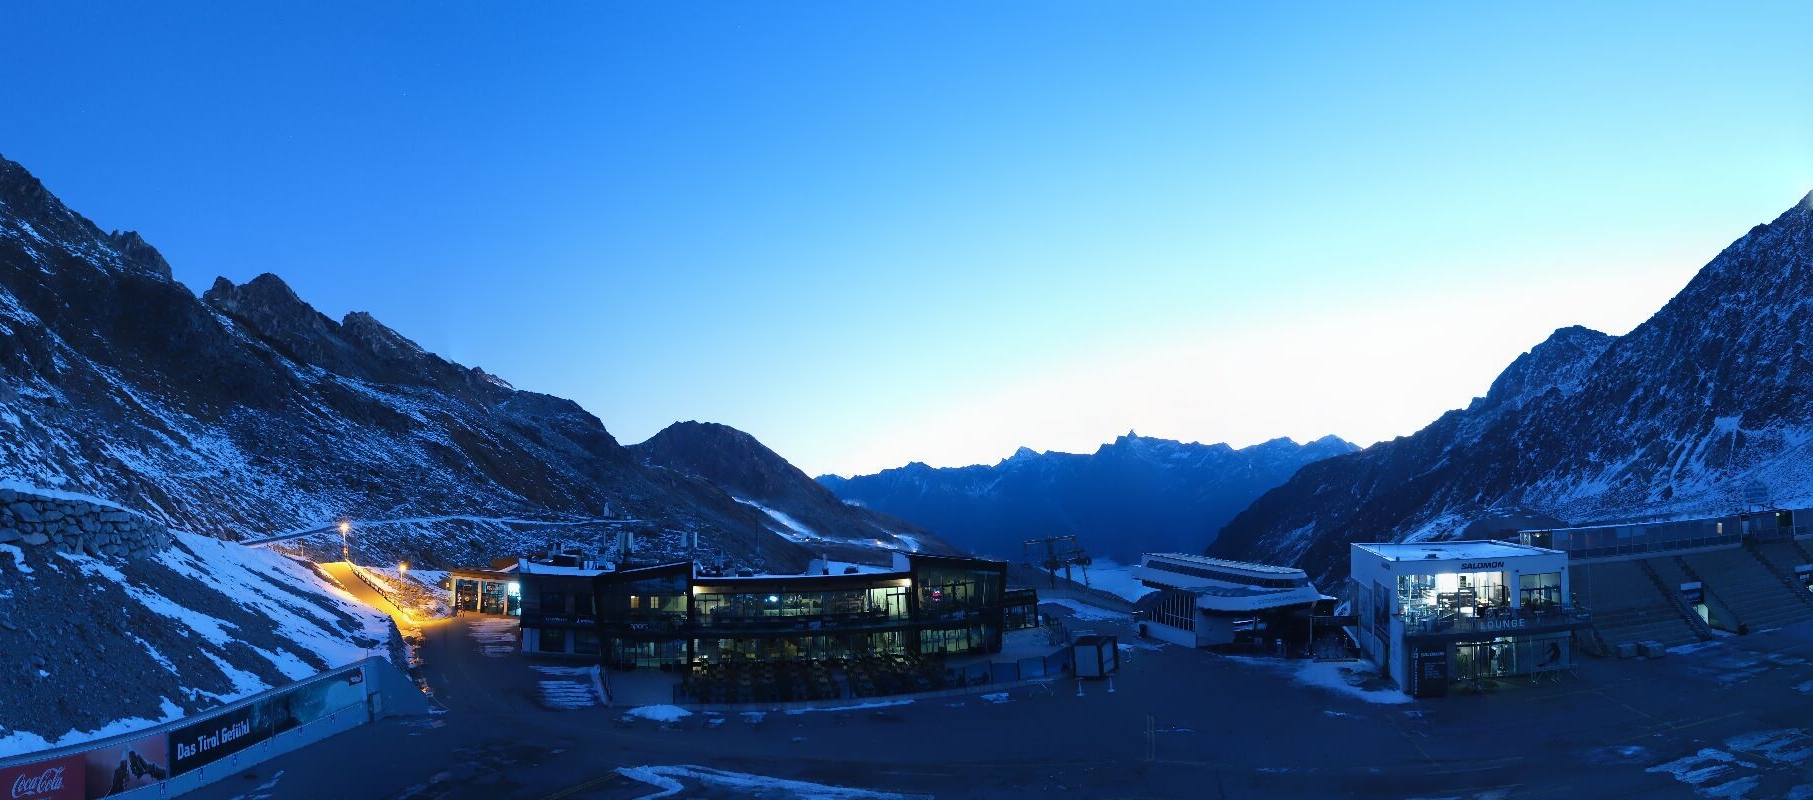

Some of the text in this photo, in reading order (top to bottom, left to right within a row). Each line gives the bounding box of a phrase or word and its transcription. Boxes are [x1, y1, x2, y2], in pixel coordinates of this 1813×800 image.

[1460, 561, 1505, 570] SALOMON
[1480, 618, 1526, 629] LOUNGE
[177, 718, 251, 761] Das Tirol Gefühl
[11, 766, 66, 799] Coca-Cola
